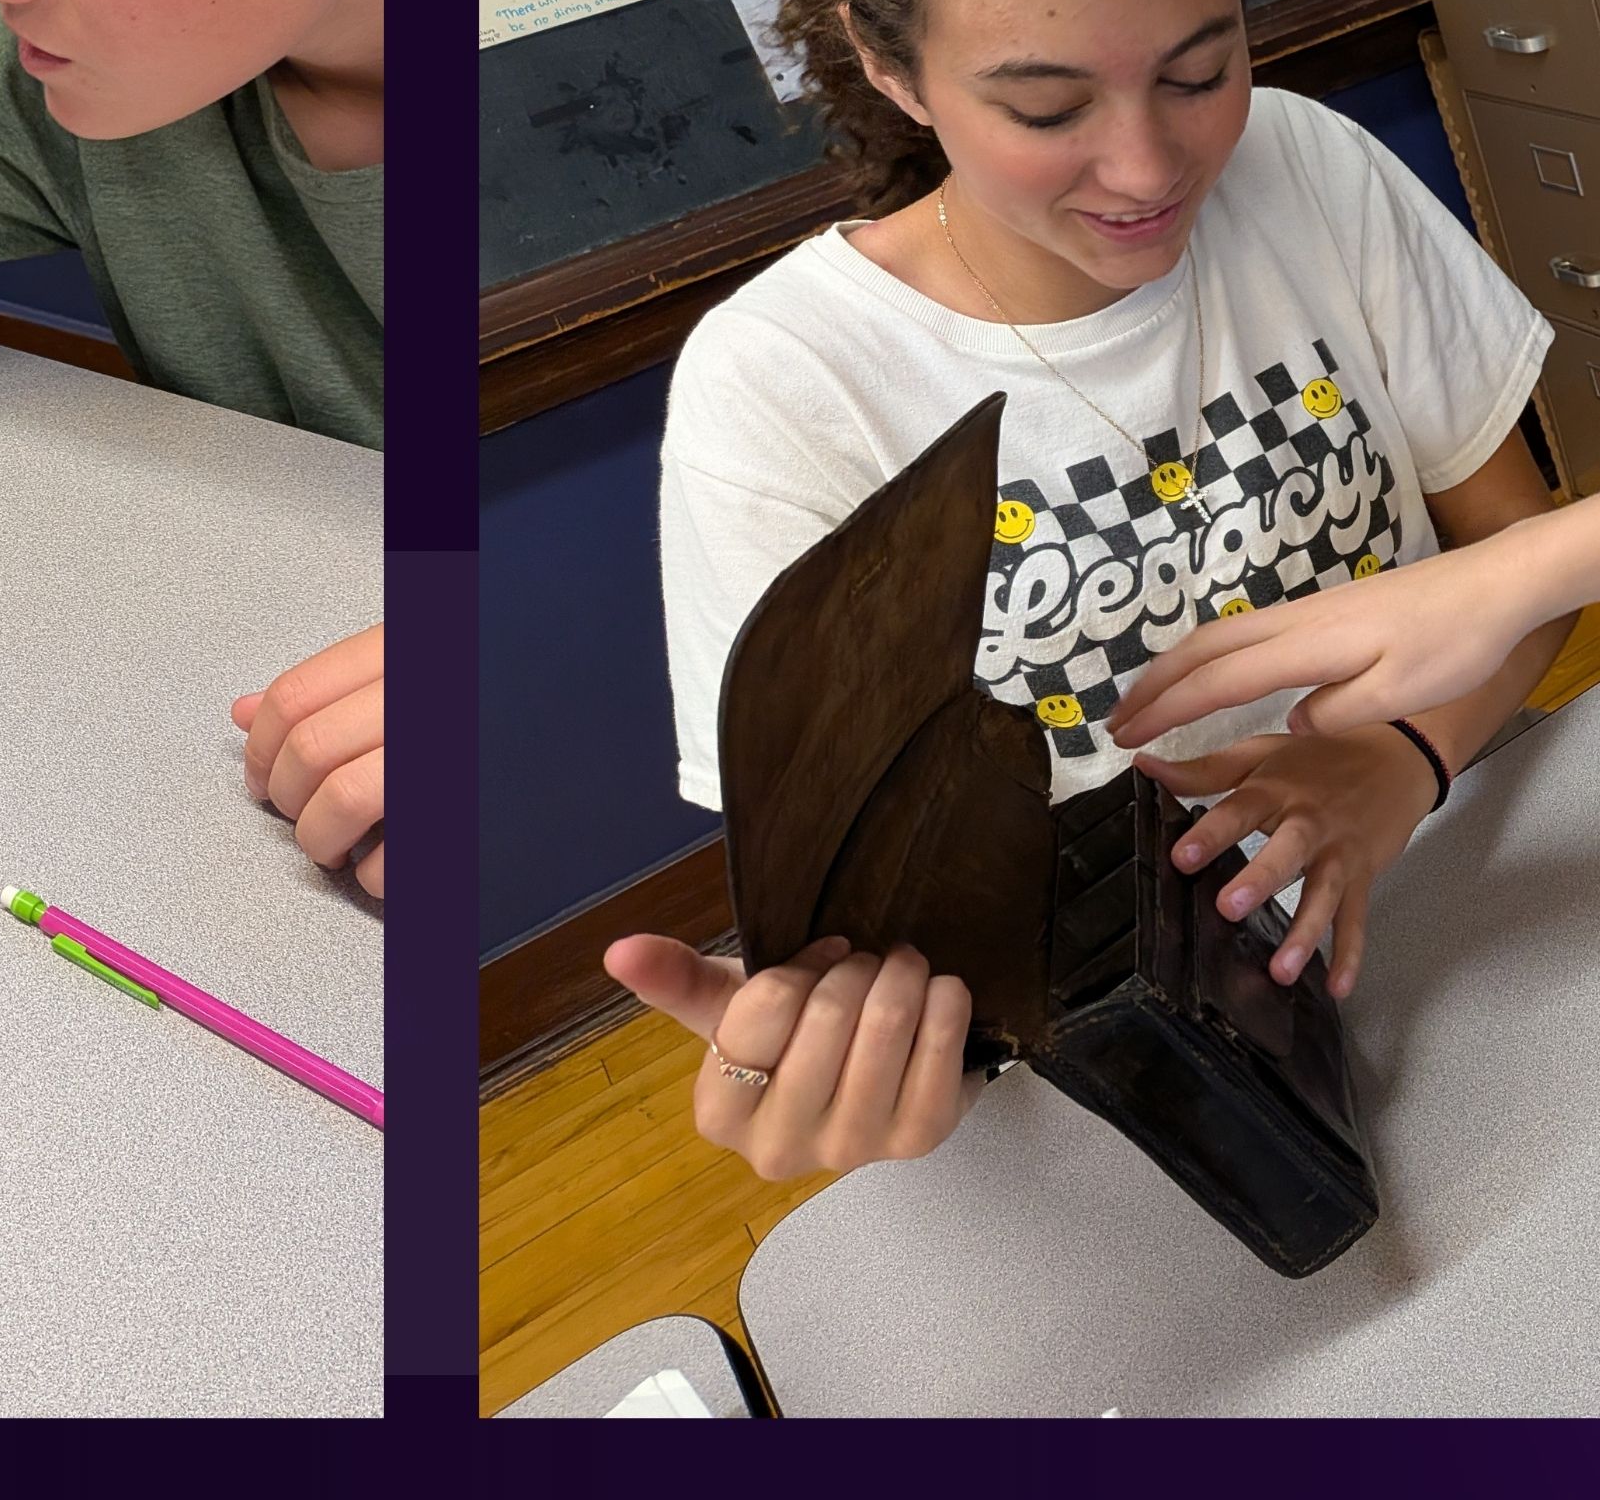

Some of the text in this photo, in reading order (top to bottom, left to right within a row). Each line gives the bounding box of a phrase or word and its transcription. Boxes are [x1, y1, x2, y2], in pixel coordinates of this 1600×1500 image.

[508, 23, 525, 33] be
[534, 17, 549, 27] no
[975, 435, 1385, 680] Legacy
